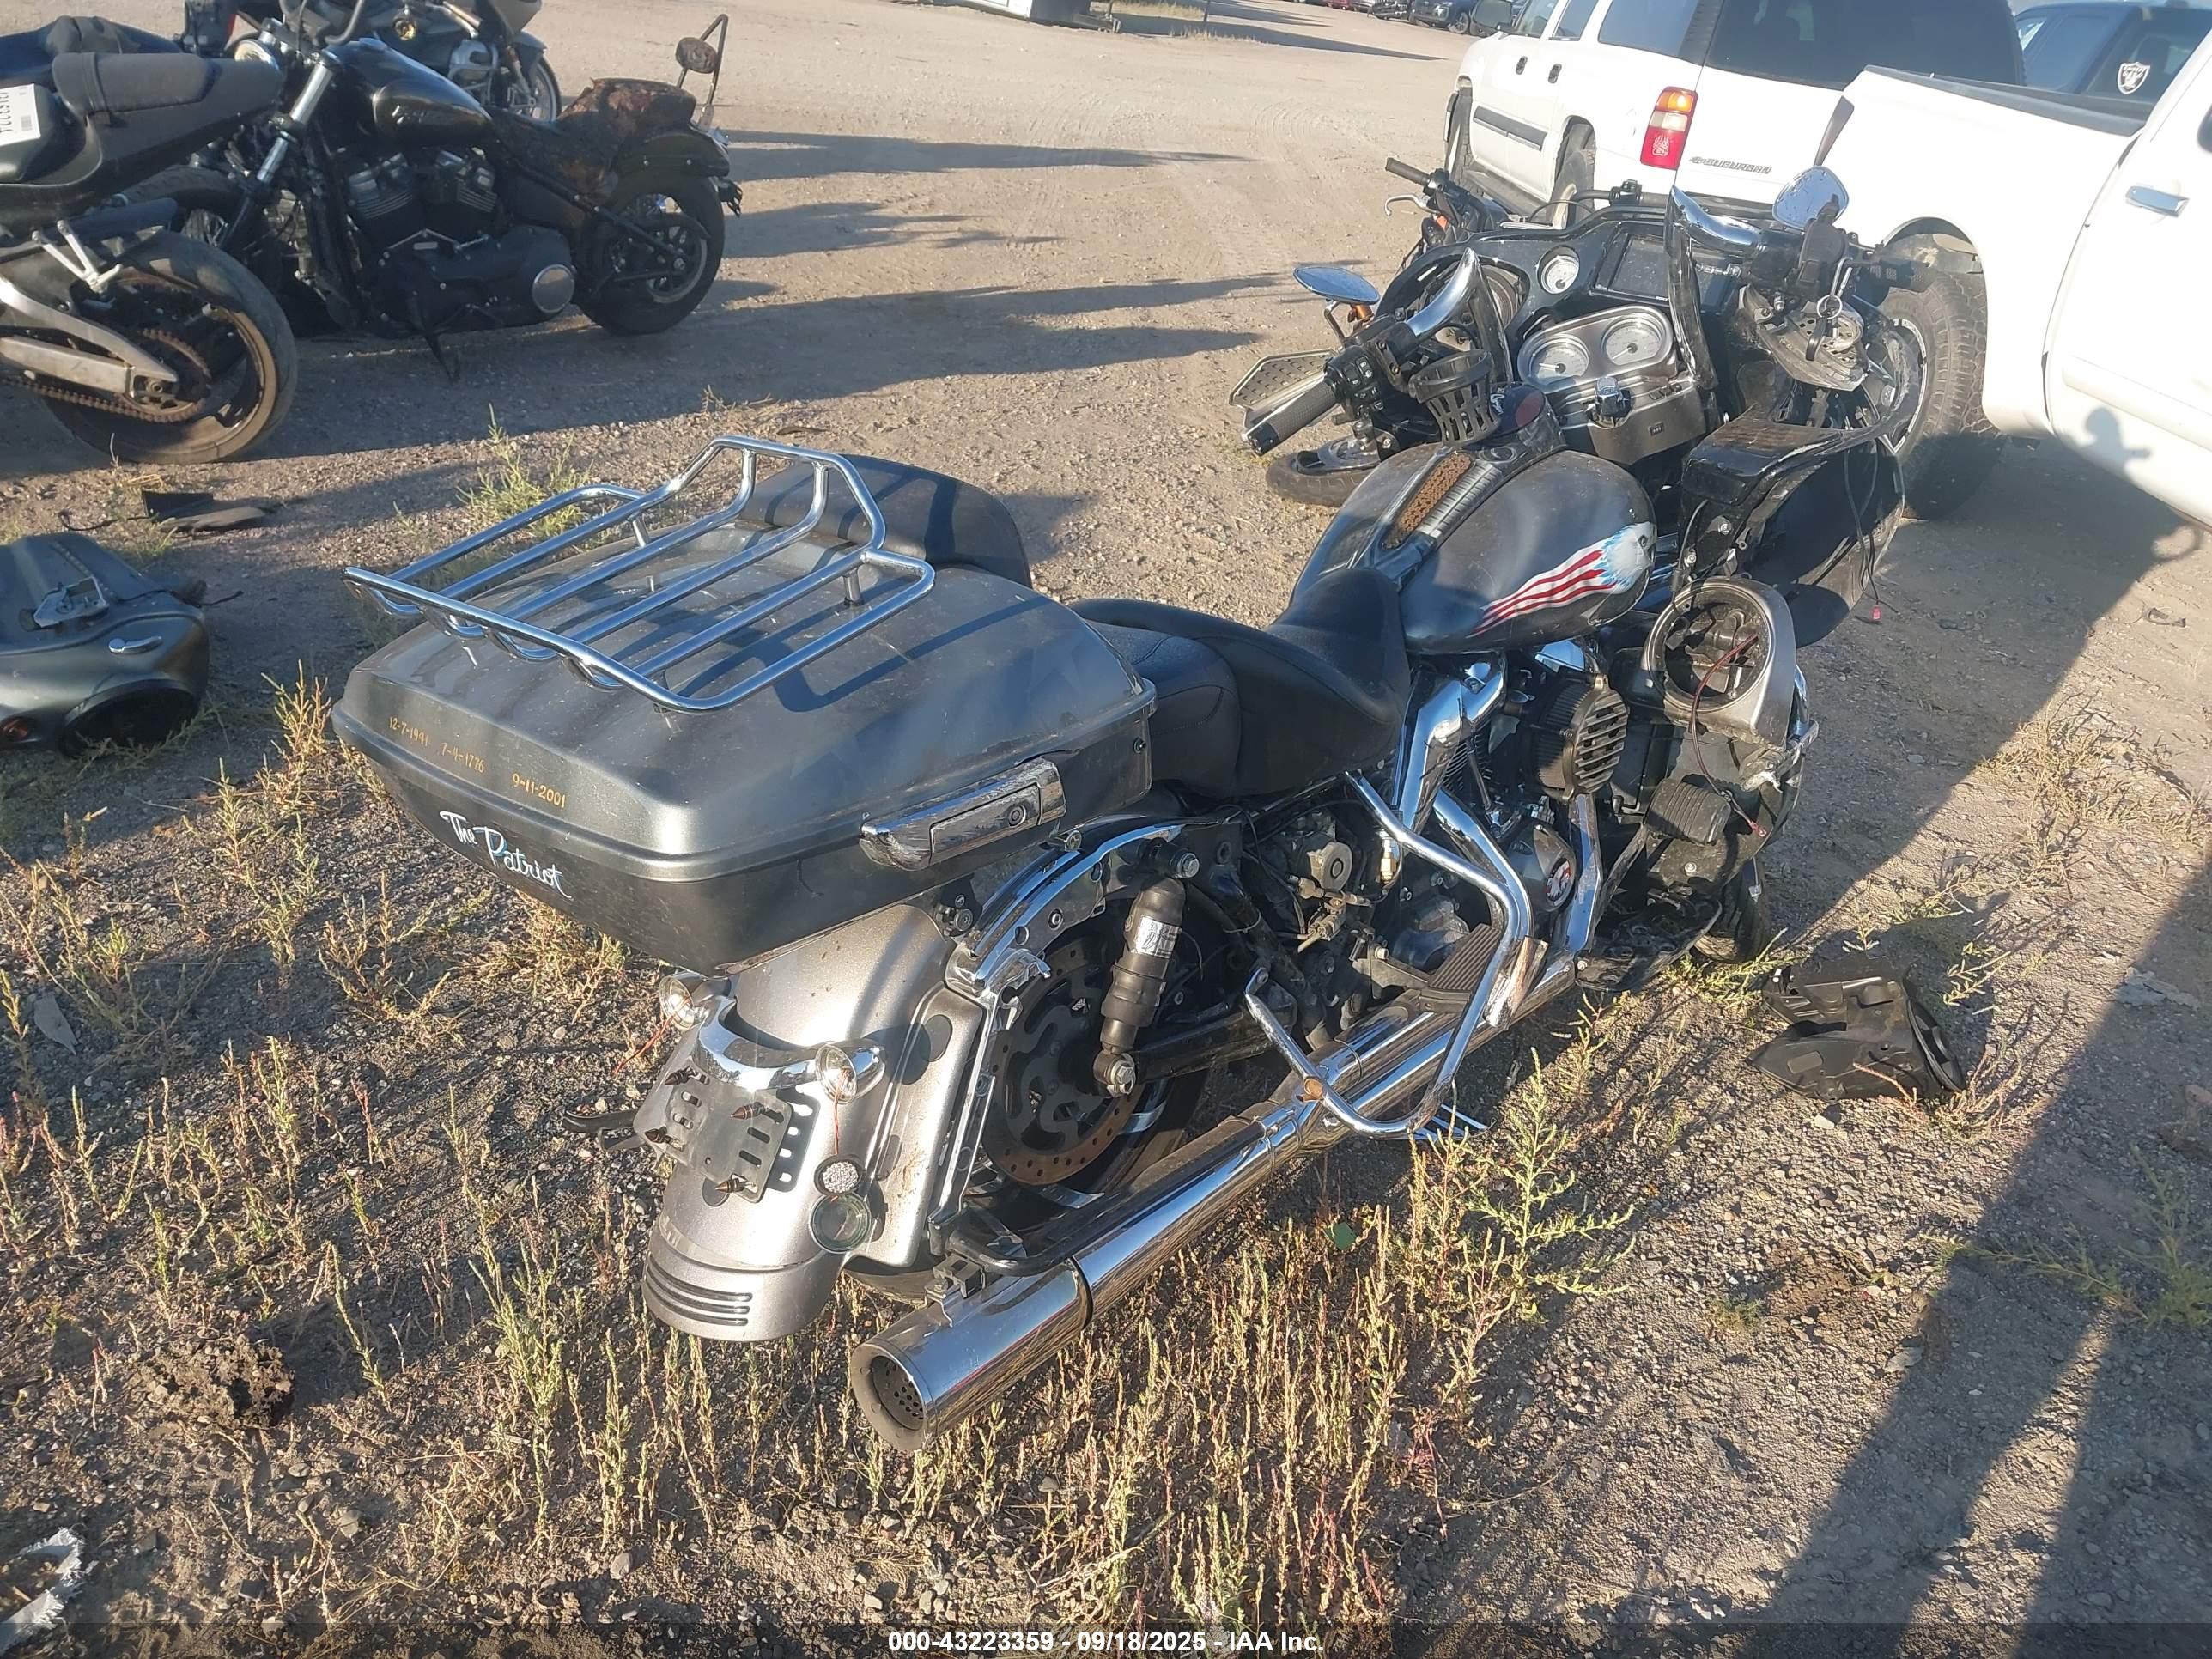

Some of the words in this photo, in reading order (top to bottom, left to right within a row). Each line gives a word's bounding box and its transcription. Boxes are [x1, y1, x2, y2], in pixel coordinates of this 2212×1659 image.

[512, 773, 567, 809] 9-11-2001
[439, 811, 478, 845] The
[472, 826, 573, 899] Patriot
